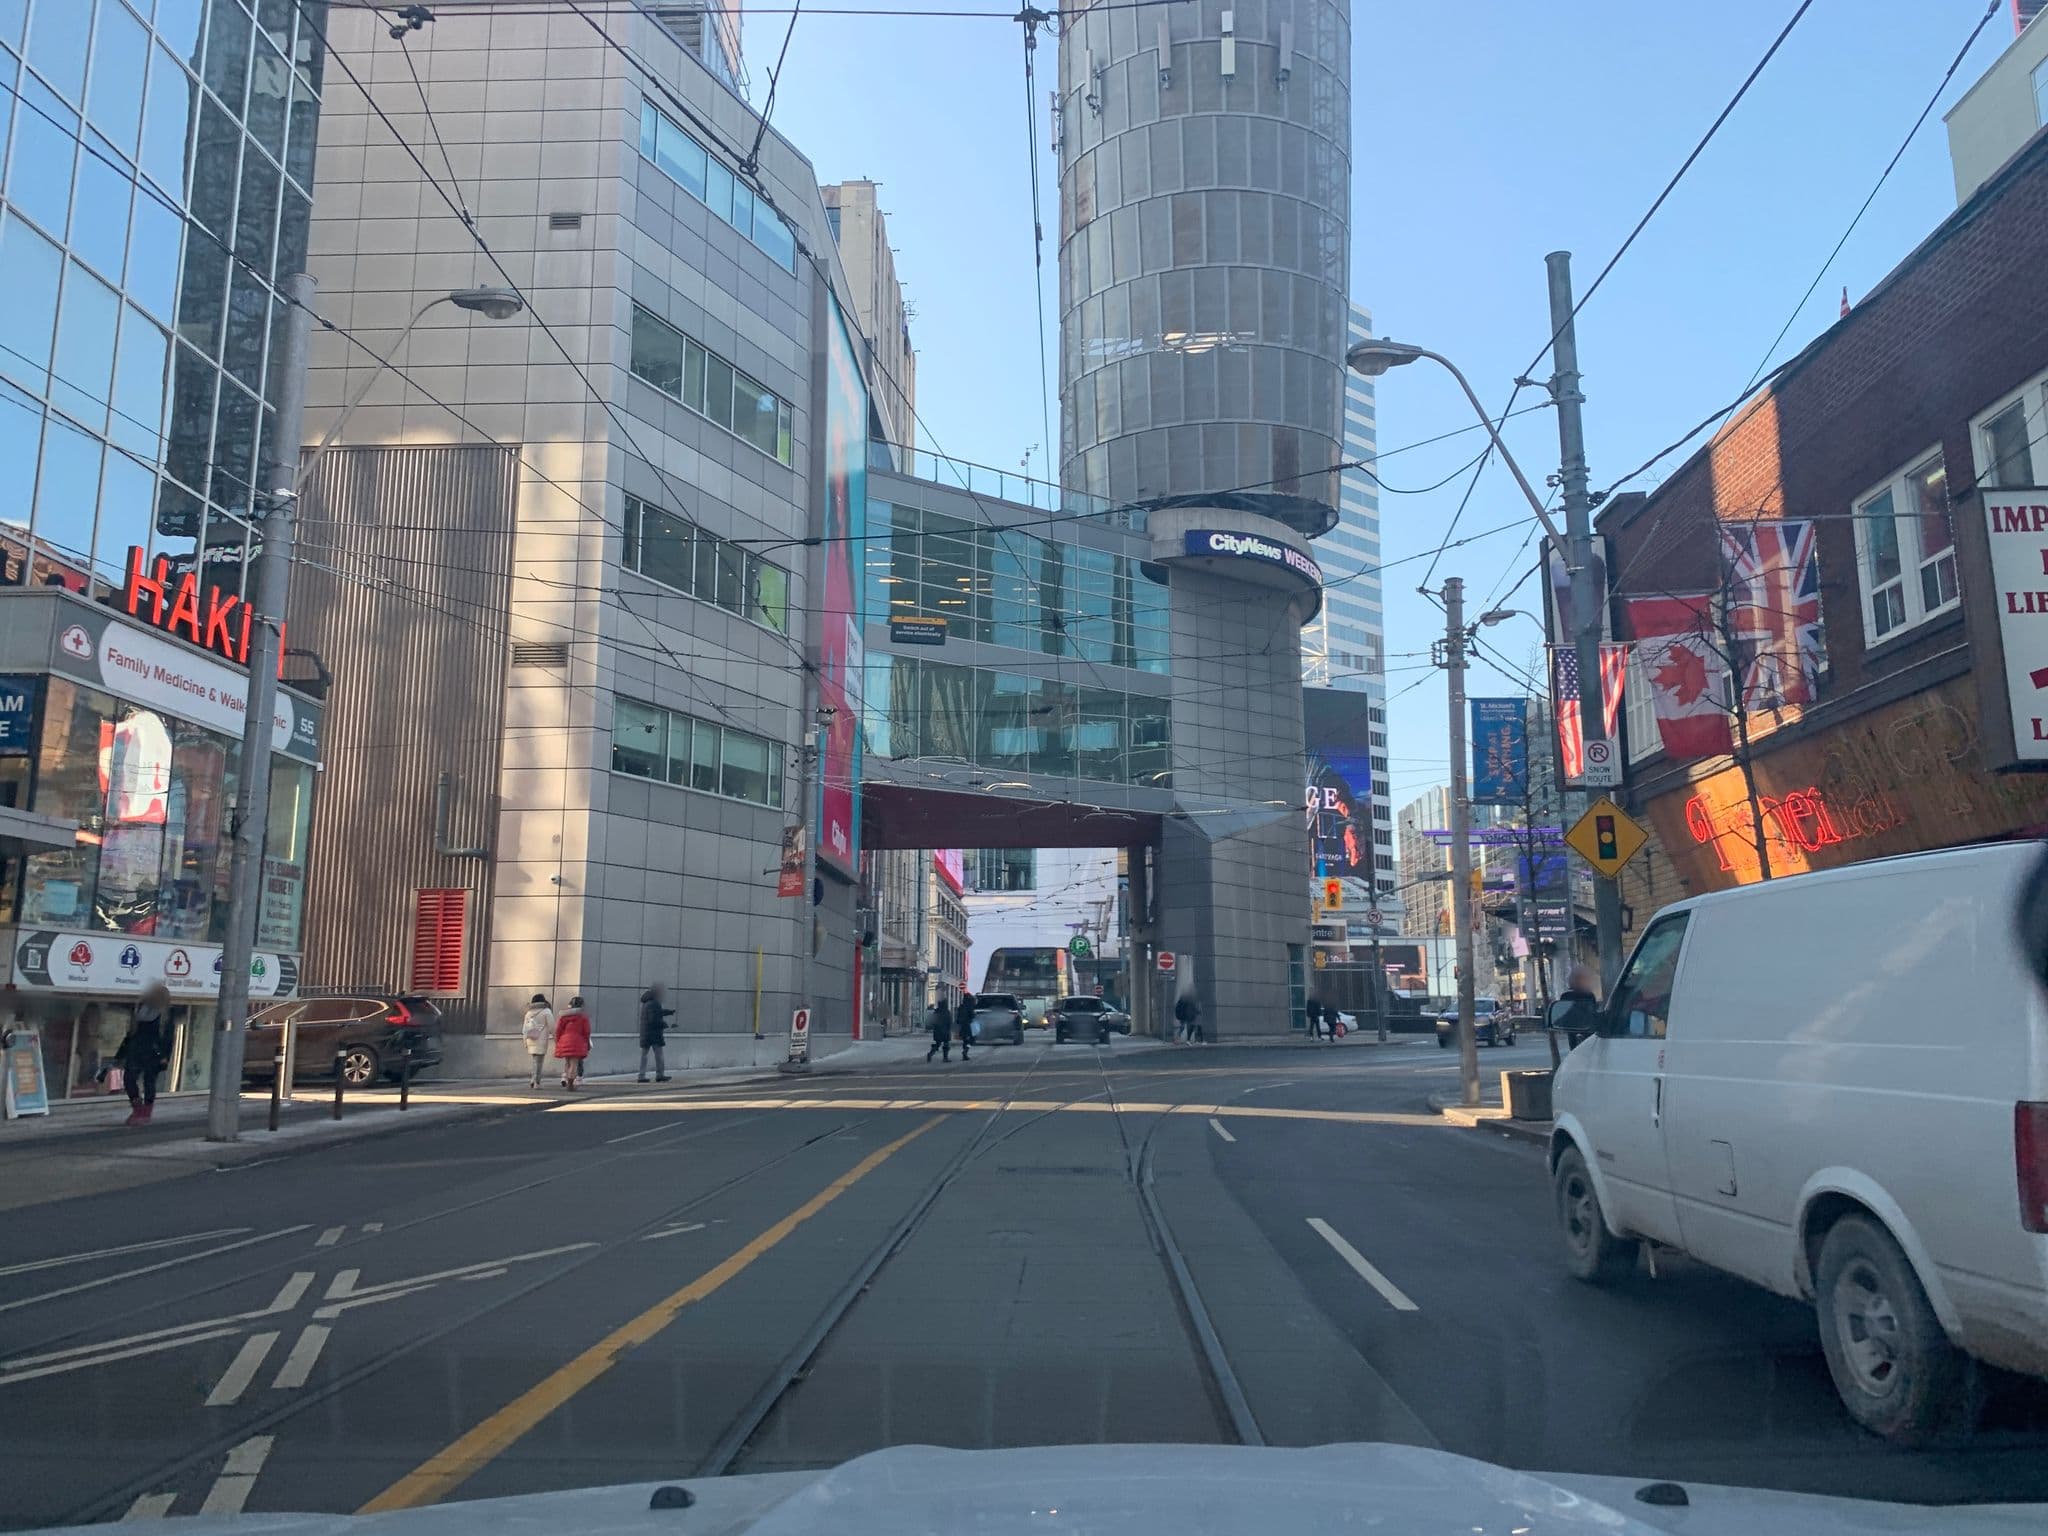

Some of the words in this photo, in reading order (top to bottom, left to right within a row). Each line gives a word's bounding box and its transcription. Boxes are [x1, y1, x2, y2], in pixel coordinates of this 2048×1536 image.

[1209, 533, 1282, 560] CityNews
[128, 546, 287, 680] HAKI
[107, 648, 150, 679] Family
[153, 665, 206, 698] Medicine
[208, 688, 216, 702] &
[220, 691, 247, 713] Walk-
[273, 715, 286, 729] nic
[300, 717, 314, 735] 55
[1312, 929, 1333, 937] entre
